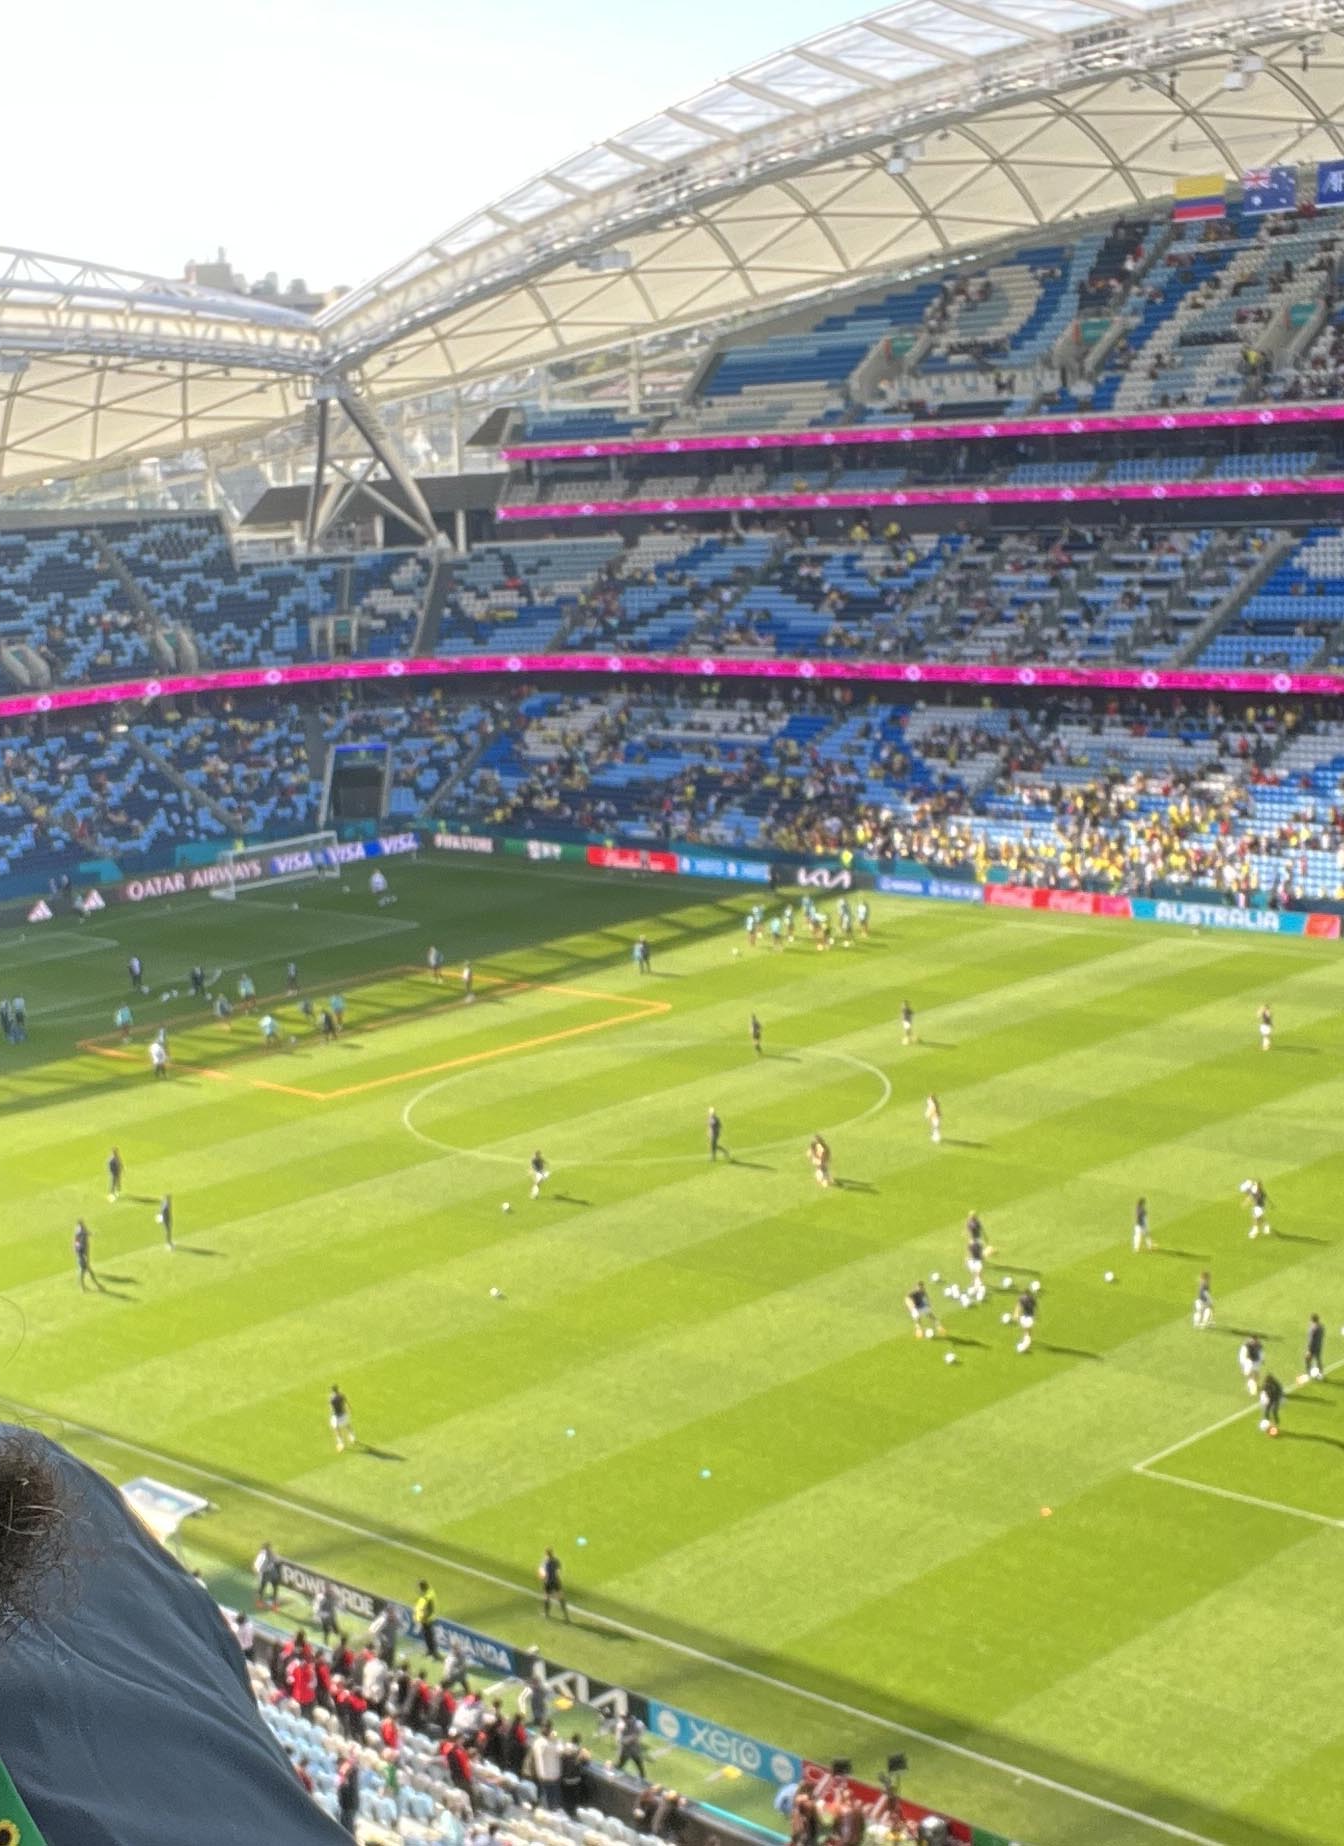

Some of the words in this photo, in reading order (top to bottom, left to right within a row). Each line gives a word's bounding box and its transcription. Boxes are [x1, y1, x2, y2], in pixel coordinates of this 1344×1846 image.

[126, 872, 186, 902] QATAR
[190, 859, 262, 889] AIRWAYS
[276, 851, 313, 874] VISA
[1156, 901, 1280, 932] AUSTRALIA
[688, 1719, 762, 1771] xero
